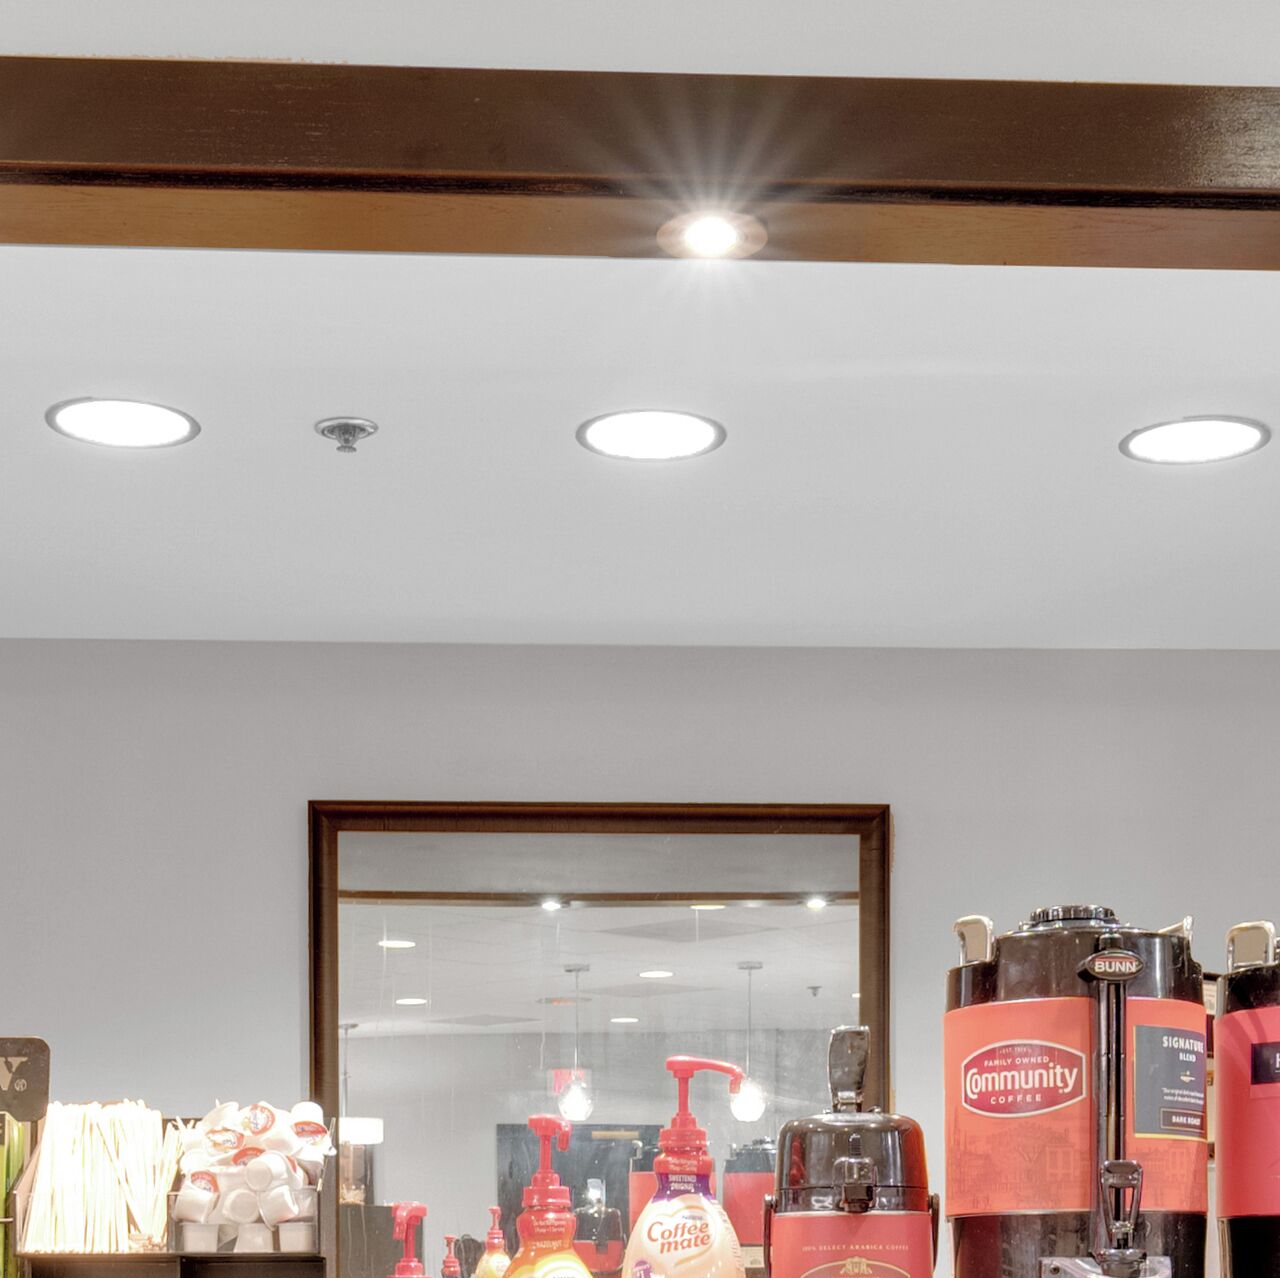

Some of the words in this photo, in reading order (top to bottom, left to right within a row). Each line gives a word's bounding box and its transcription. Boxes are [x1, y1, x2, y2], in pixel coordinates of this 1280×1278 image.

[1095, 961, 1137, 973] BUNN
[1162, 1036, 1204, 1054] SIGNATURE
[984, 1059, 1012, 1067] FAMILY
[1015, 1056, 1050, 1064] OWNED
[1179, 1053, 1196, 1063] BLEND
[966, 1062, 1078, 1099] Community
[990, 1094, 1042, 1104] COFFEE
[647, 1221, 709, 1242] Coffee
[660, 1234, 711, 1254] mate
